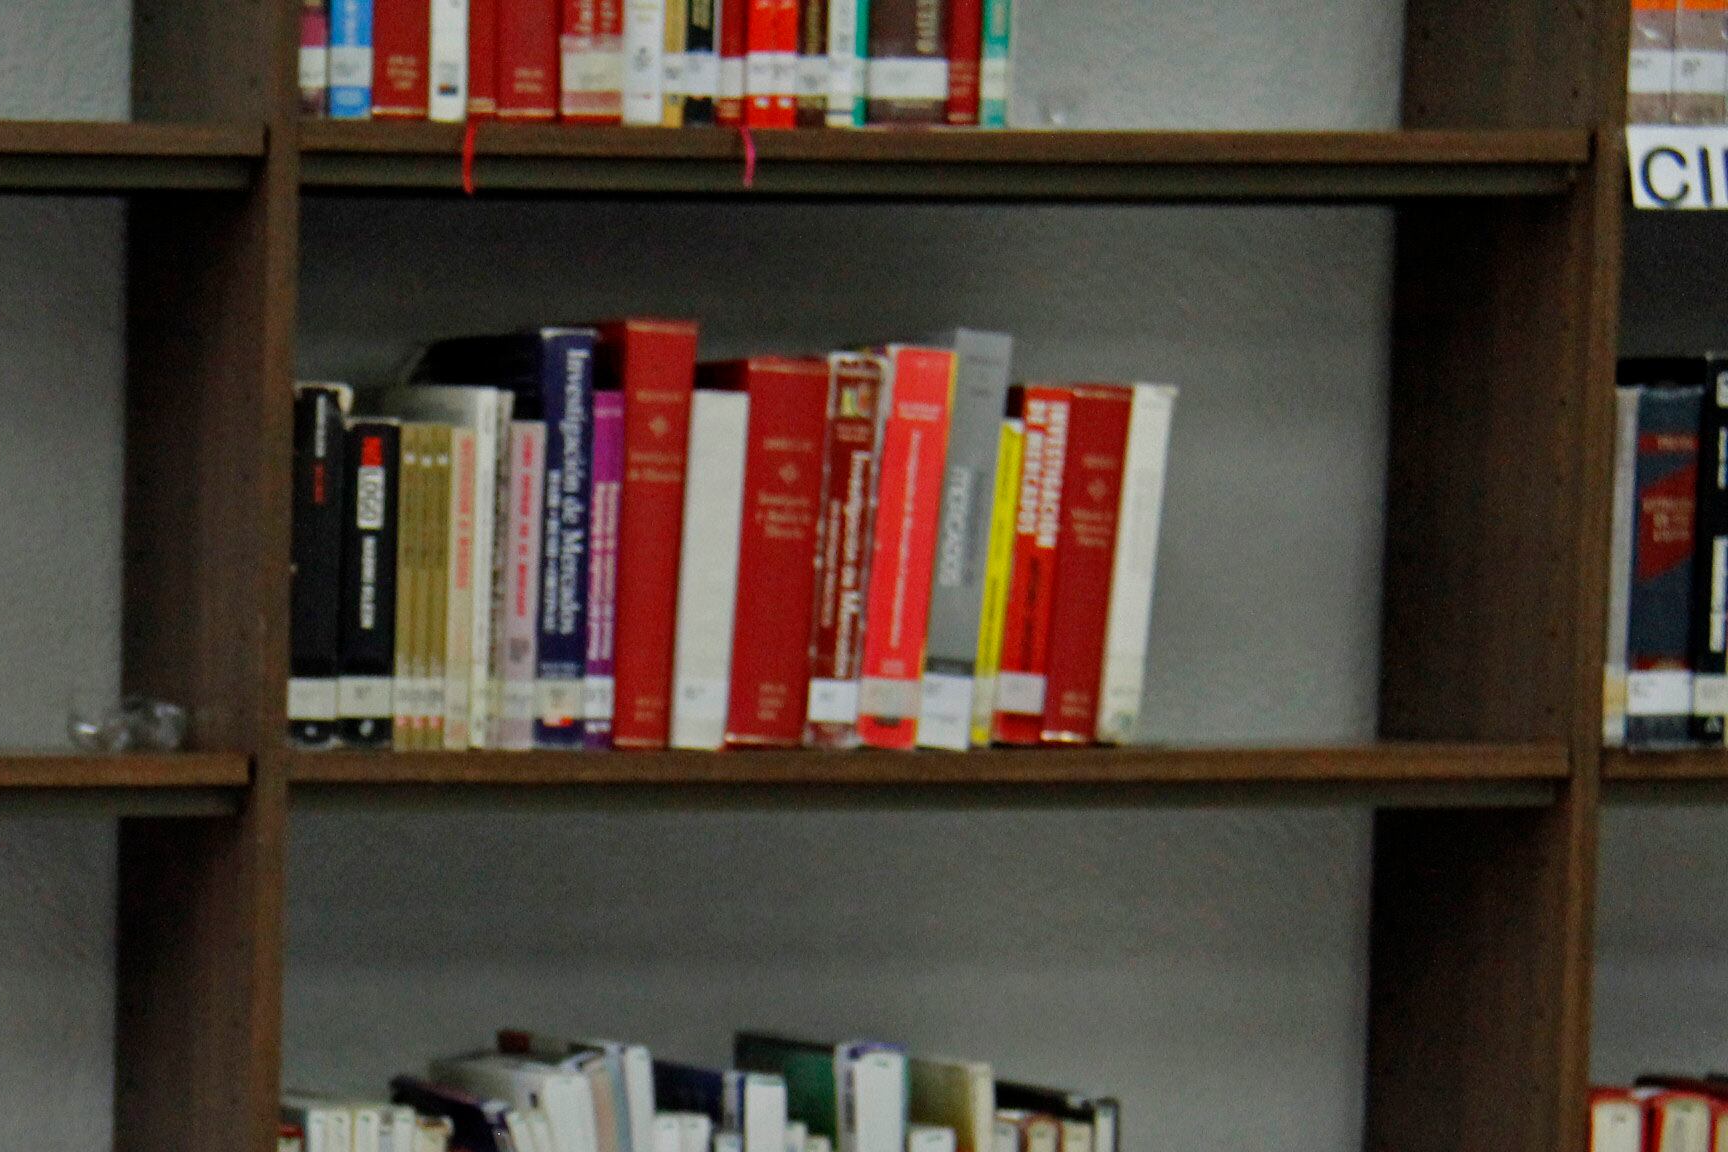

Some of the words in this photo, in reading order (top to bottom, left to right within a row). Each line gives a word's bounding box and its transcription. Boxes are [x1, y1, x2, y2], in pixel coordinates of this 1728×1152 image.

[1641, 146, 1728, 207] CI
[561, 348, 590, 494] Investigación
[562, 497, 583, 524] de
[559, 531, 585, 634] Mercados
